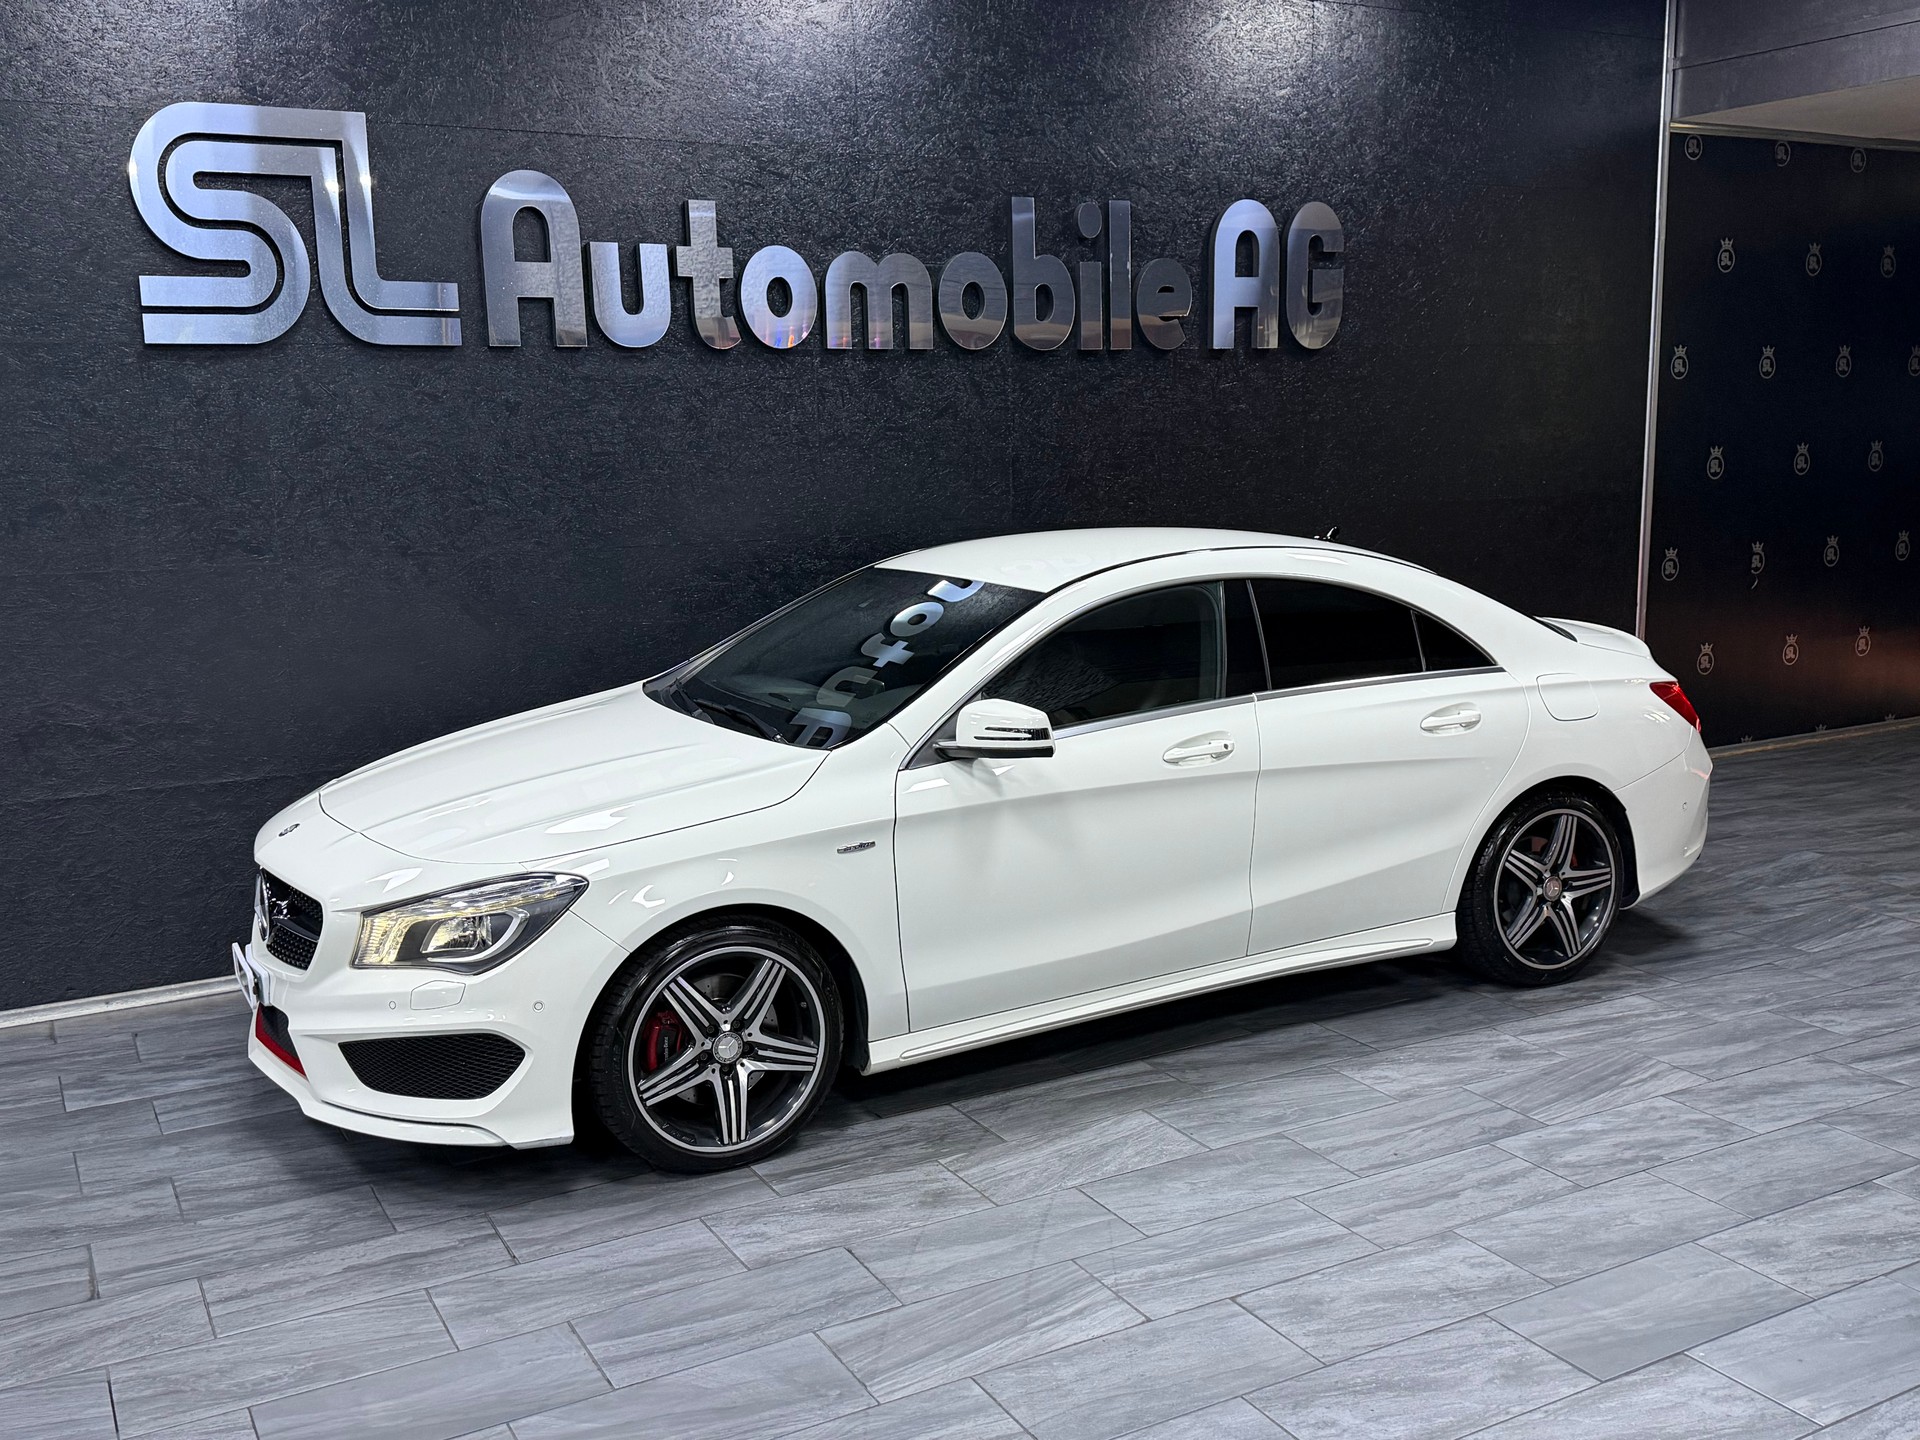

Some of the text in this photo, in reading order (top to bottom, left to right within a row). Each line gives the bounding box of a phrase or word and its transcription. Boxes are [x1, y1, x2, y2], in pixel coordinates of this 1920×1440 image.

[129, 102, 1344, 350] SL Automobile AG
